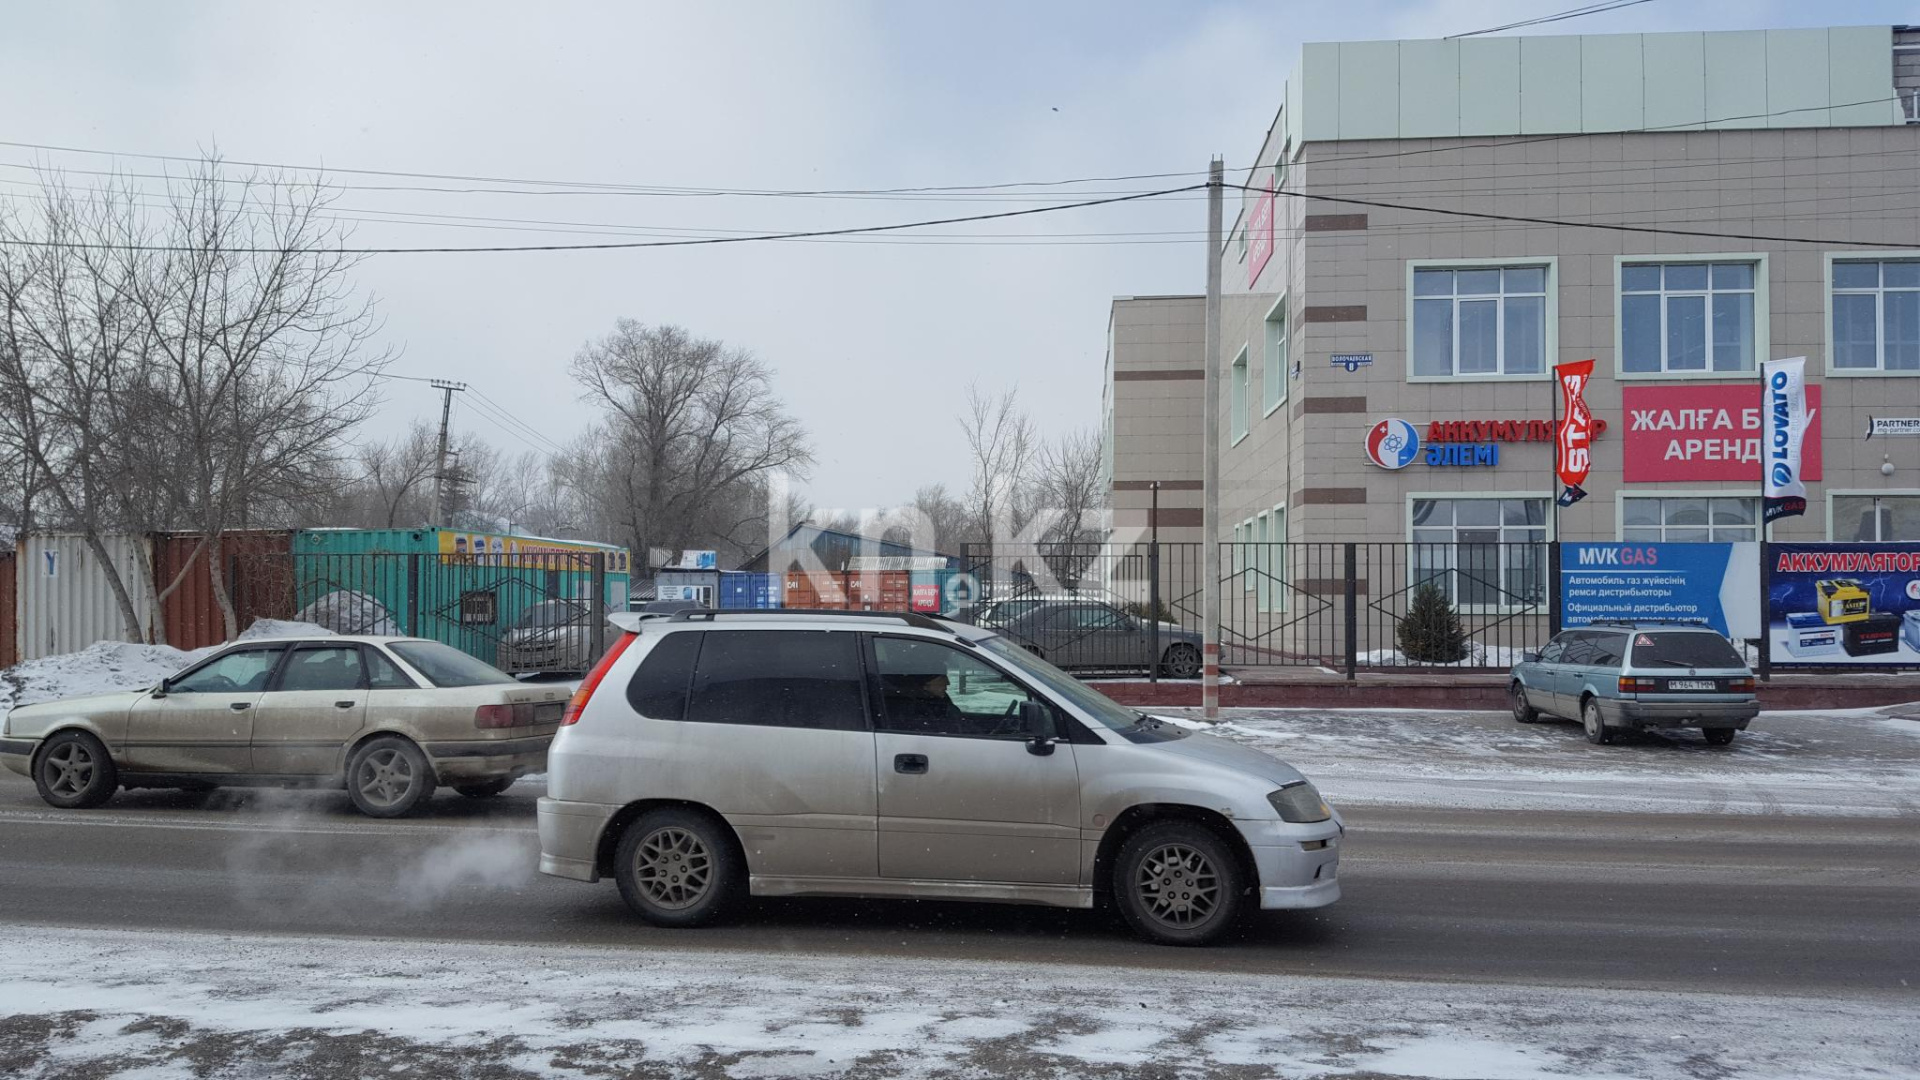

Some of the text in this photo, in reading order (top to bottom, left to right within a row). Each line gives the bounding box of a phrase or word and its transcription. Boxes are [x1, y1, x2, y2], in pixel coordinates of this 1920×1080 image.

[1349, 362, 1354, 371] 8
[1630, 408, 1733, 431] ЖАЛҒА
[1771, 371, 1790, 460] LOVATO
[1425, 443, 1499, 466] ӘЛЕМІ
[1664, 438, 1762, 464] АРЕНД
[1579, 547, 1658, 565] MVK GAS
[1569, 576, 1625, 585] Автомобиль
[1627, 577, 1640, 585] газ
[1598, 587, 1672, 598] дистрибьюторы
[1567, 602, 1698, 613] Официальный дистрибьютор
